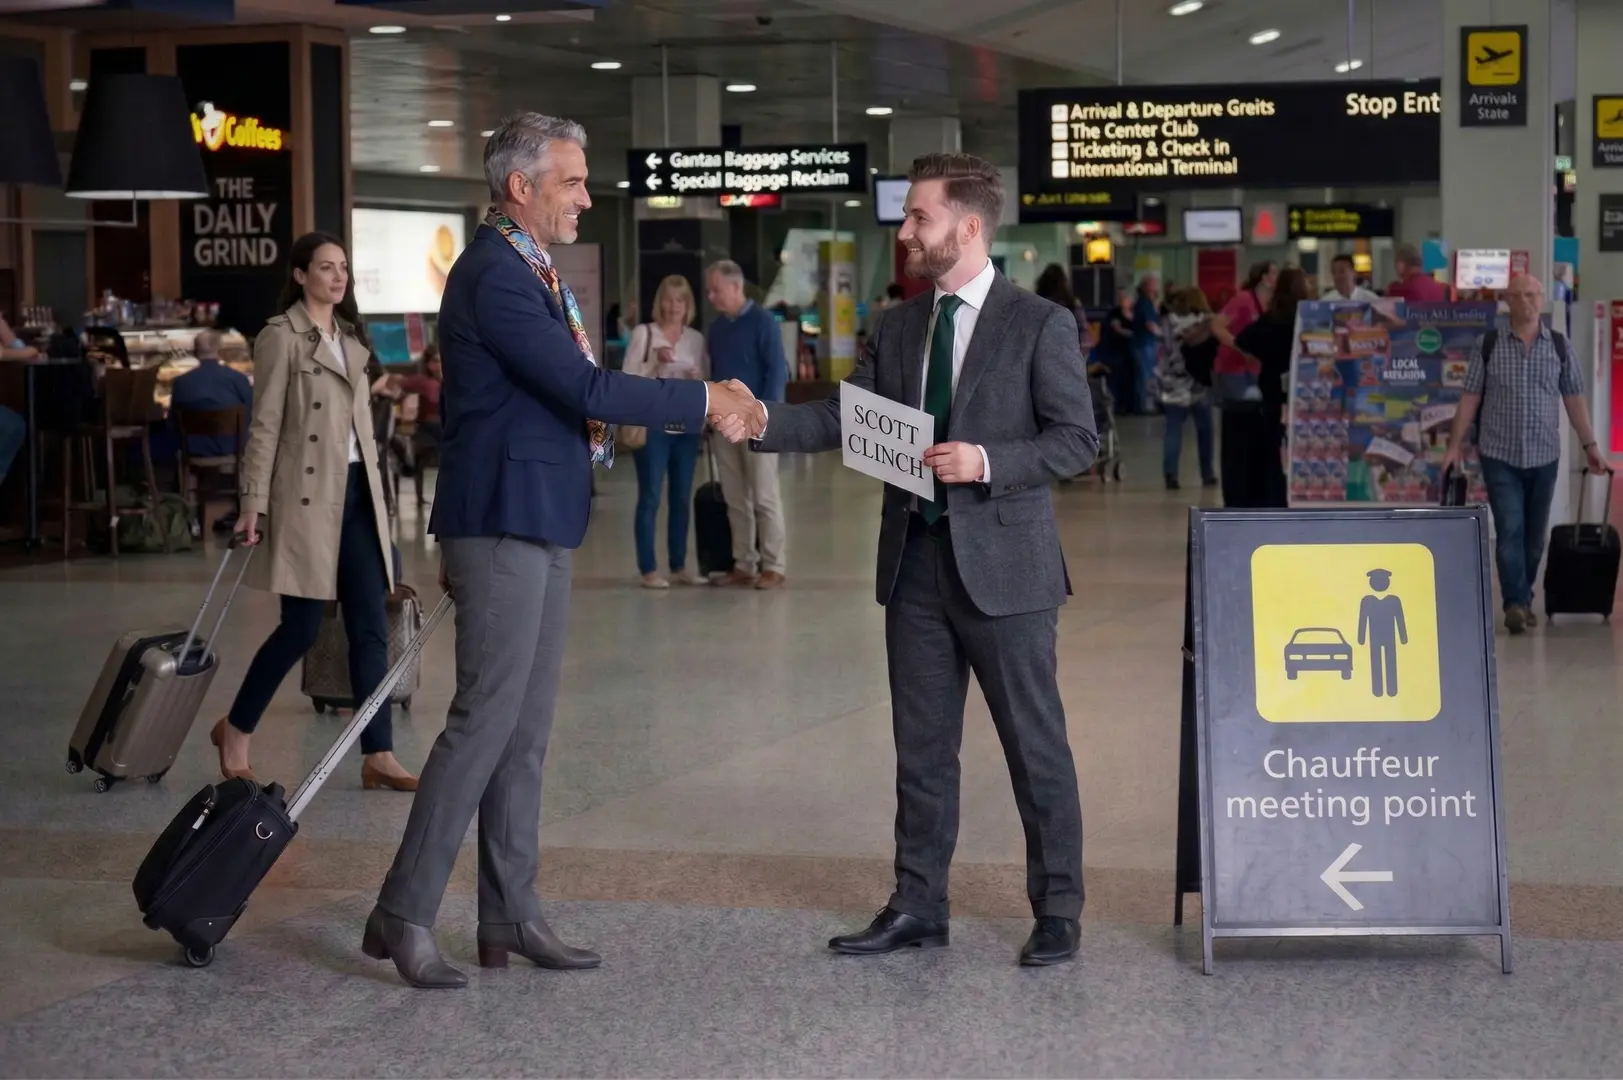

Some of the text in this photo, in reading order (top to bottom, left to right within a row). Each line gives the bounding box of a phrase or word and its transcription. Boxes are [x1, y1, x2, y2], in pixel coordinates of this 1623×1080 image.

[1345, 92, 1441, 118] Stop Ent
[1469, 92, 1518, 105] Arrivals
[1070, 102, 1122, 120] Arrival
[1126, 102, 1139, 119] &
[1142, 101, 1223, 121] Departure
[1478, 108, 1510, 120] State
[1070, 120, 1199, 140] The Center Club
[725, 151, 788, 170] Baggage
[790, 148, 850, 166] Services
[1070, 138, 1230, 161] Ticketing & Check in
[1070, 158, 1238, 178] International Terminal
[216, 177, 254, 198] THE
[670, 169, 849, 192] Special Baggage Reclaim
[194, 203, 278, 235] DAILY
[194, 238, 278, 266] GRIND
[1392, 358, 1419, 369] LOCAL
[854, 404, 919, 445] SCOTT
[848, 433, 925, 480] CLINCH
[1263, 747, 1439, 778] Chauffeur
[1226, 788, 1476, 826] meeting point
